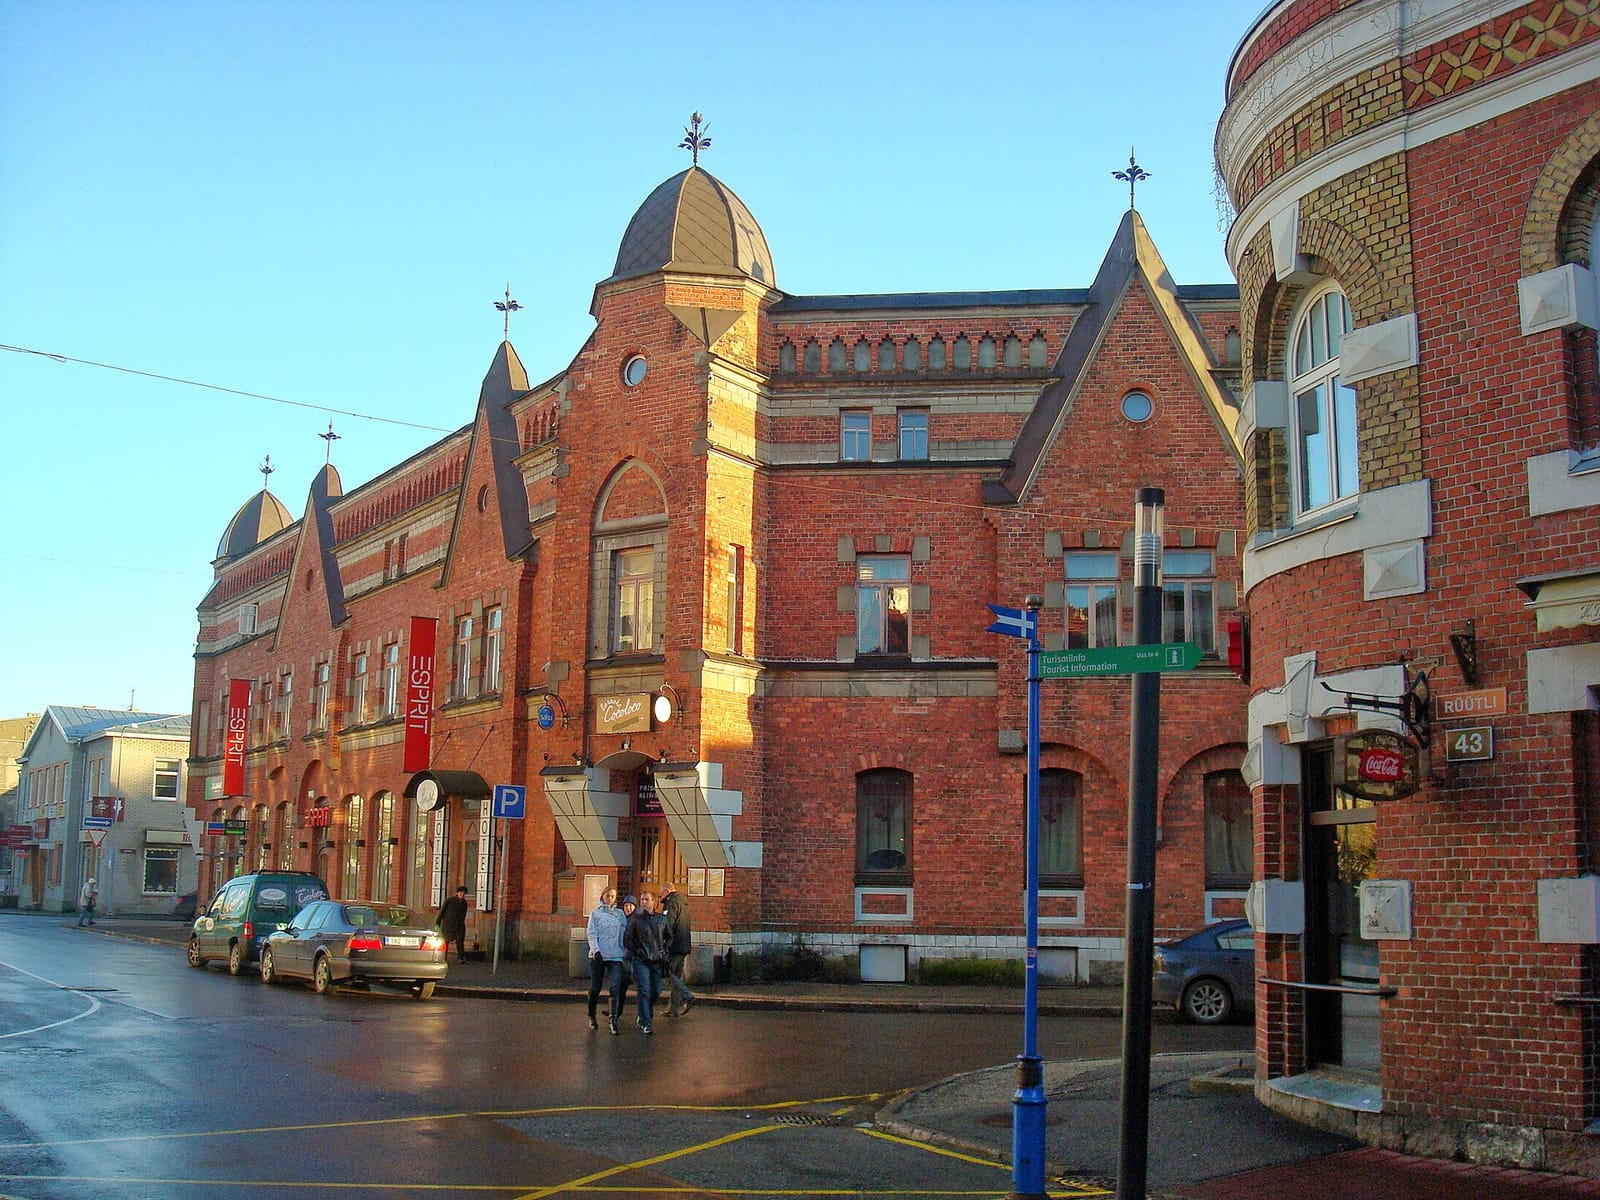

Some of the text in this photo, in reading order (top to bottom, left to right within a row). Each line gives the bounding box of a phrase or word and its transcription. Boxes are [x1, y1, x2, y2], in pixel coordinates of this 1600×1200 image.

[1042, 653, 1086, 664] Turismiinfo
[1042, 662, 1117, 674] Tourist Information
[409, 656, 432, 735] ESPRIT
[1443, 695, 1497, 714] RÜÜTLI
[603, 698, 643, 723] Cocoloco
[228, 707, 247, 767] ESPRIT
[1454, 732, 1483, 754] 43
[500, 788, 520, 815] P
[479, 801, 489, 907] HOTELL
